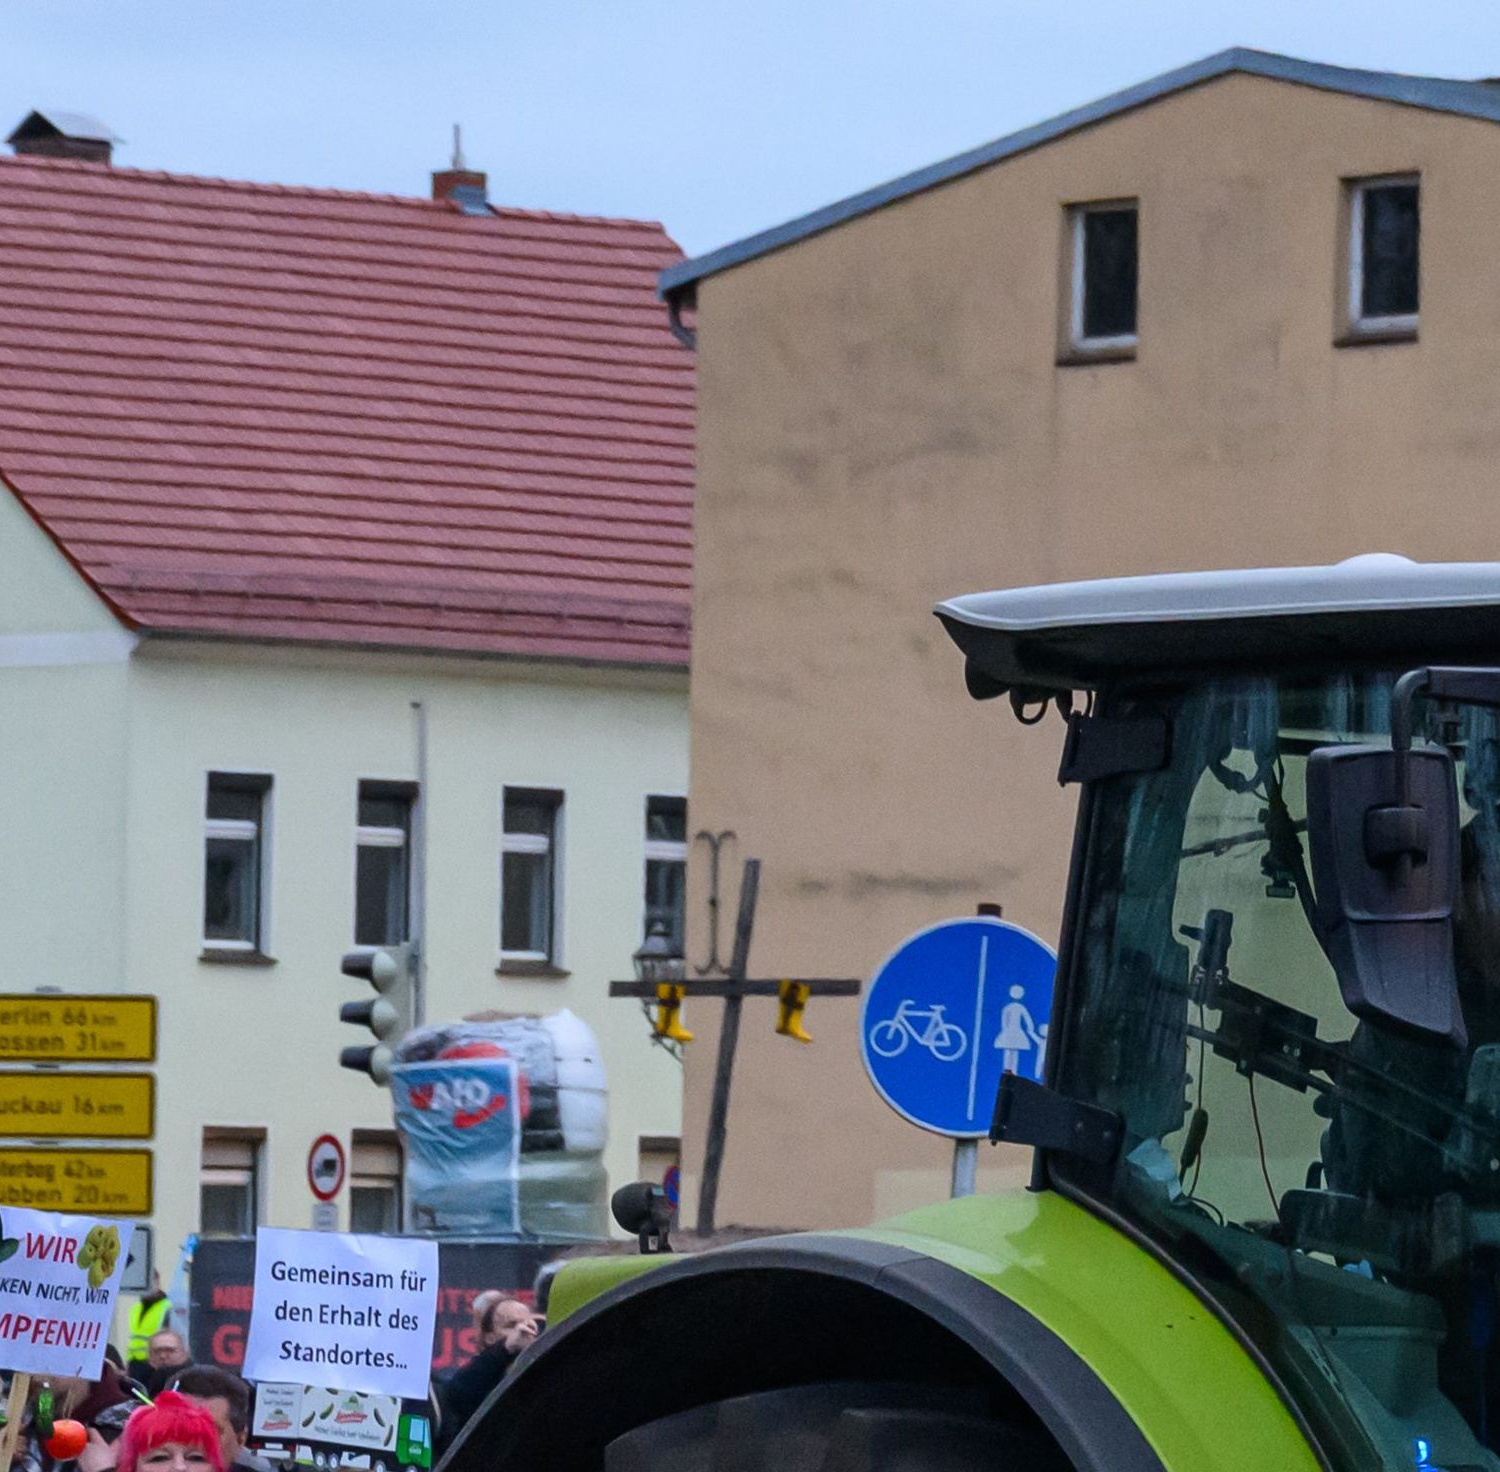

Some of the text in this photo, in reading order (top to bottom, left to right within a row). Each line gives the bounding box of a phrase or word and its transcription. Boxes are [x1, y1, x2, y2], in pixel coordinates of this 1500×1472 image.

[63, 1006, 88, 1026] 66
[76, 1032, 97, 1051] 31
[74, 1096, 94, 1115] 16
[74, 1186, 98, 1204] 20
[26, 1233, 78, 1264] WIR
[271, 1260, 428, 1292] Gemeinsam für
[35, 1283, 81, 1305] NICHT,
[85, 1288, 110, 1305] WIR
[274, 1300, 419, 1332] den Erhalt des
